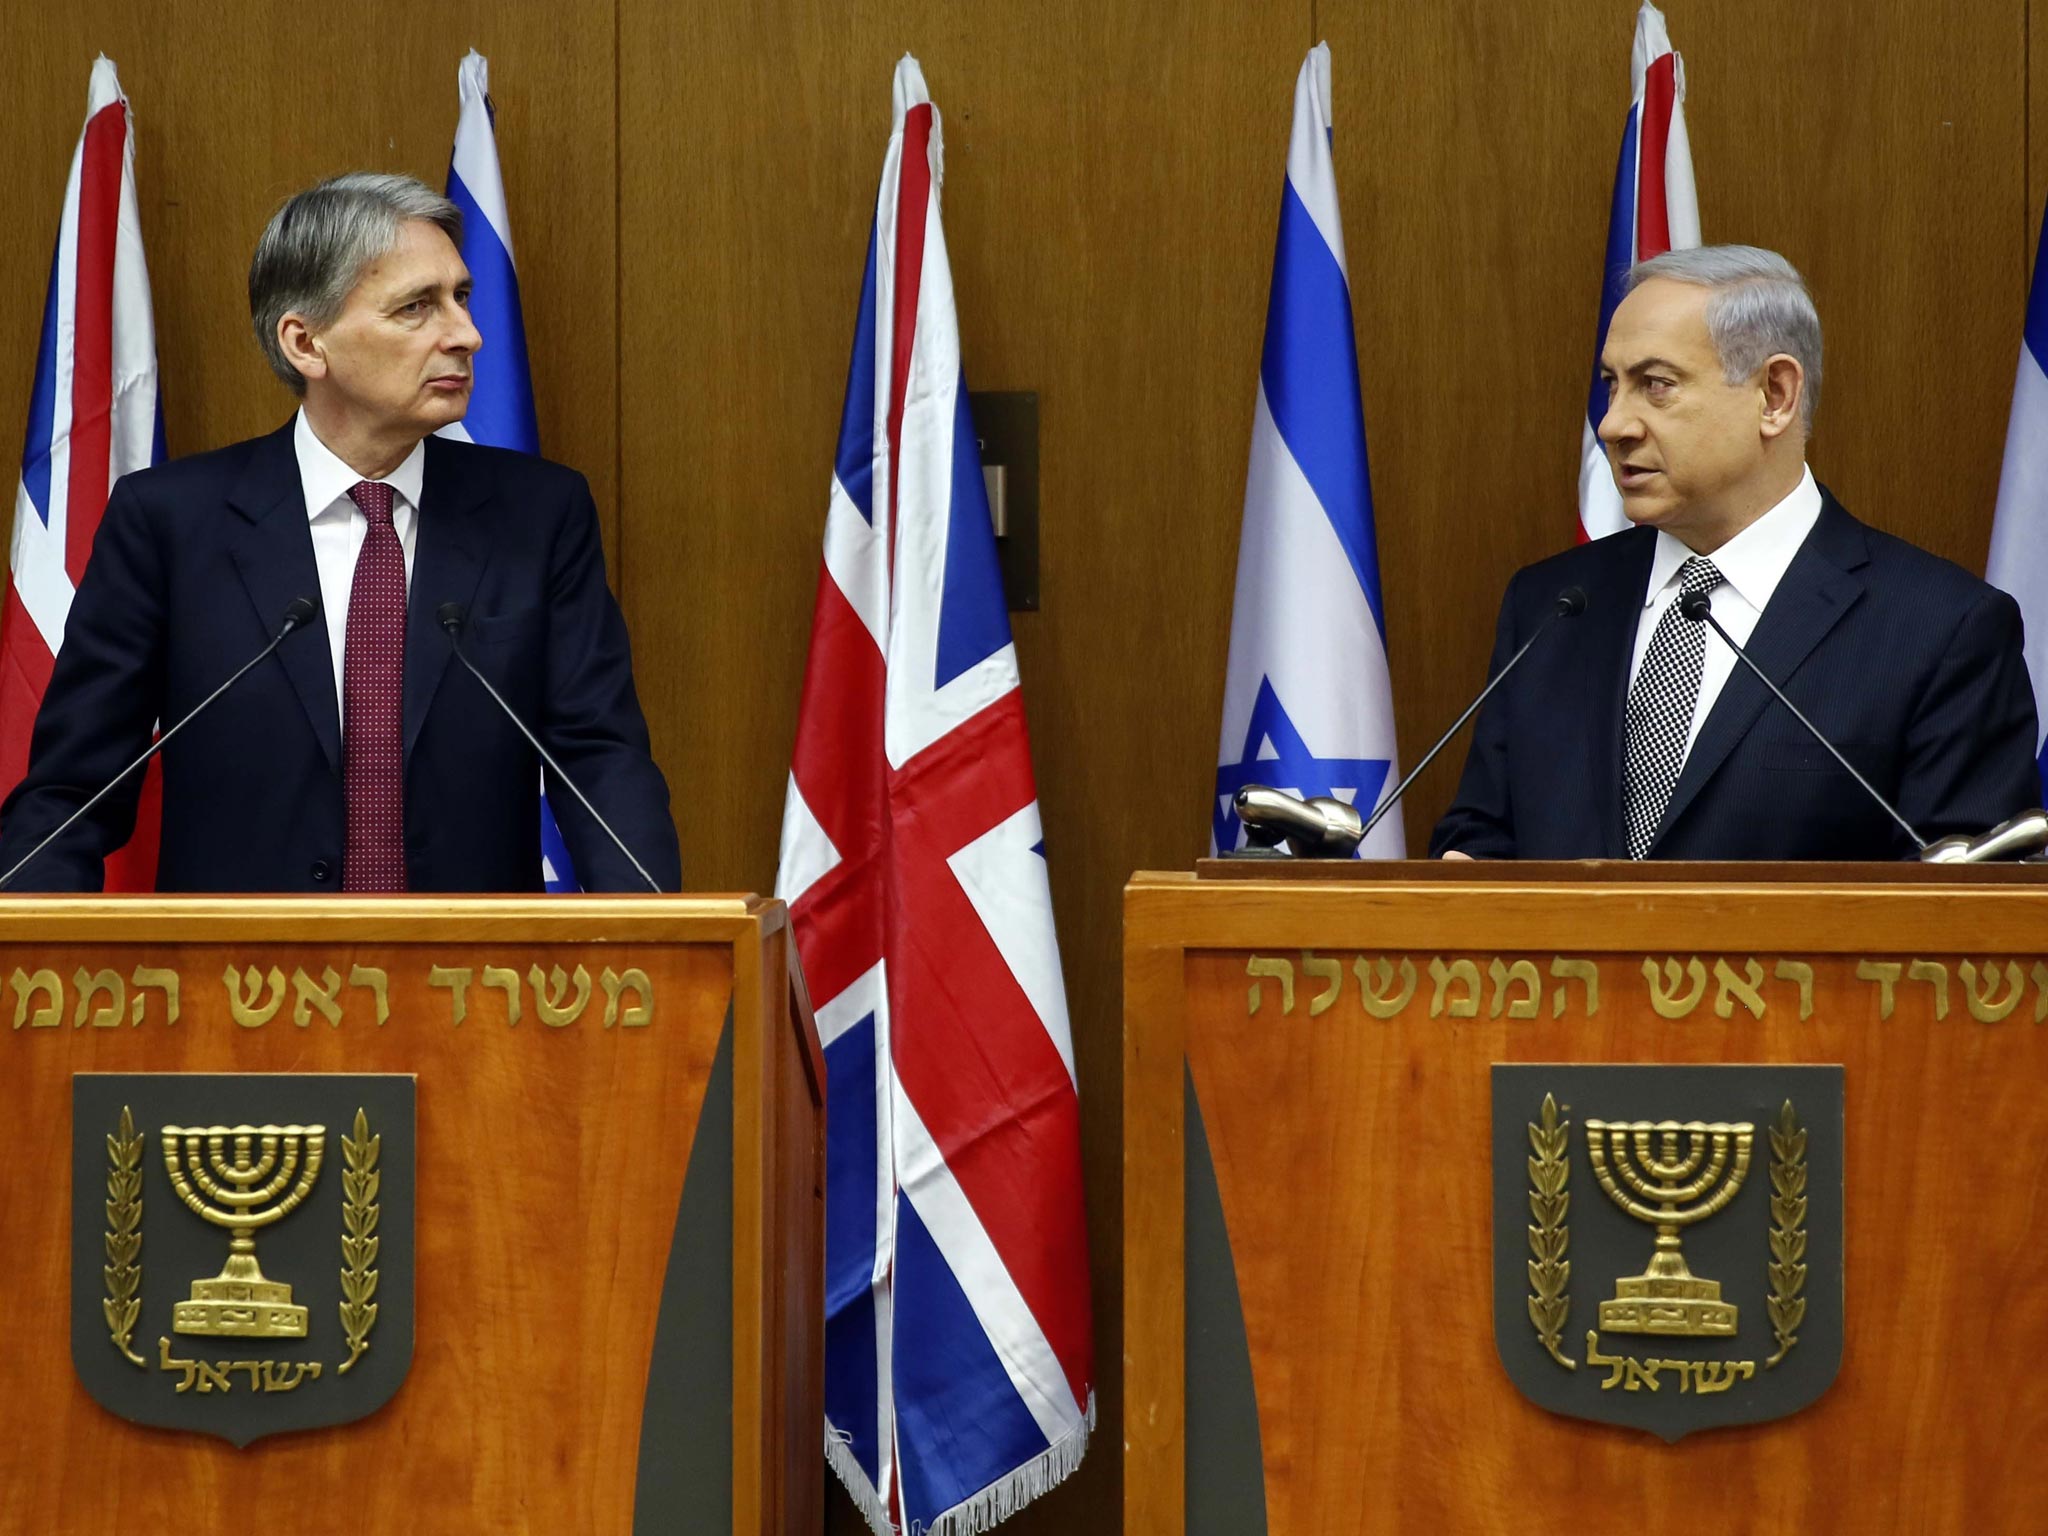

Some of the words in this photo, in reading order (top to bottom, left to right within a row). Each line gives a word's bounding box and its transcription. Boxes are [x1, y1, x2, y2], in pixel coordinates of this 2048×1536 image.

[0, 964, 181, 1030] הממ
[223, 964, 389, 1028] ראש
[428, 964, 654, 1028] משרד
[1246, 949, 1600, 1020] הממשלה
[1642, 955, 1814, 1020] ראש
[159, 1337, 322, 1392] ישראל
[1587, 1330, 1756, 1394] ישראל
